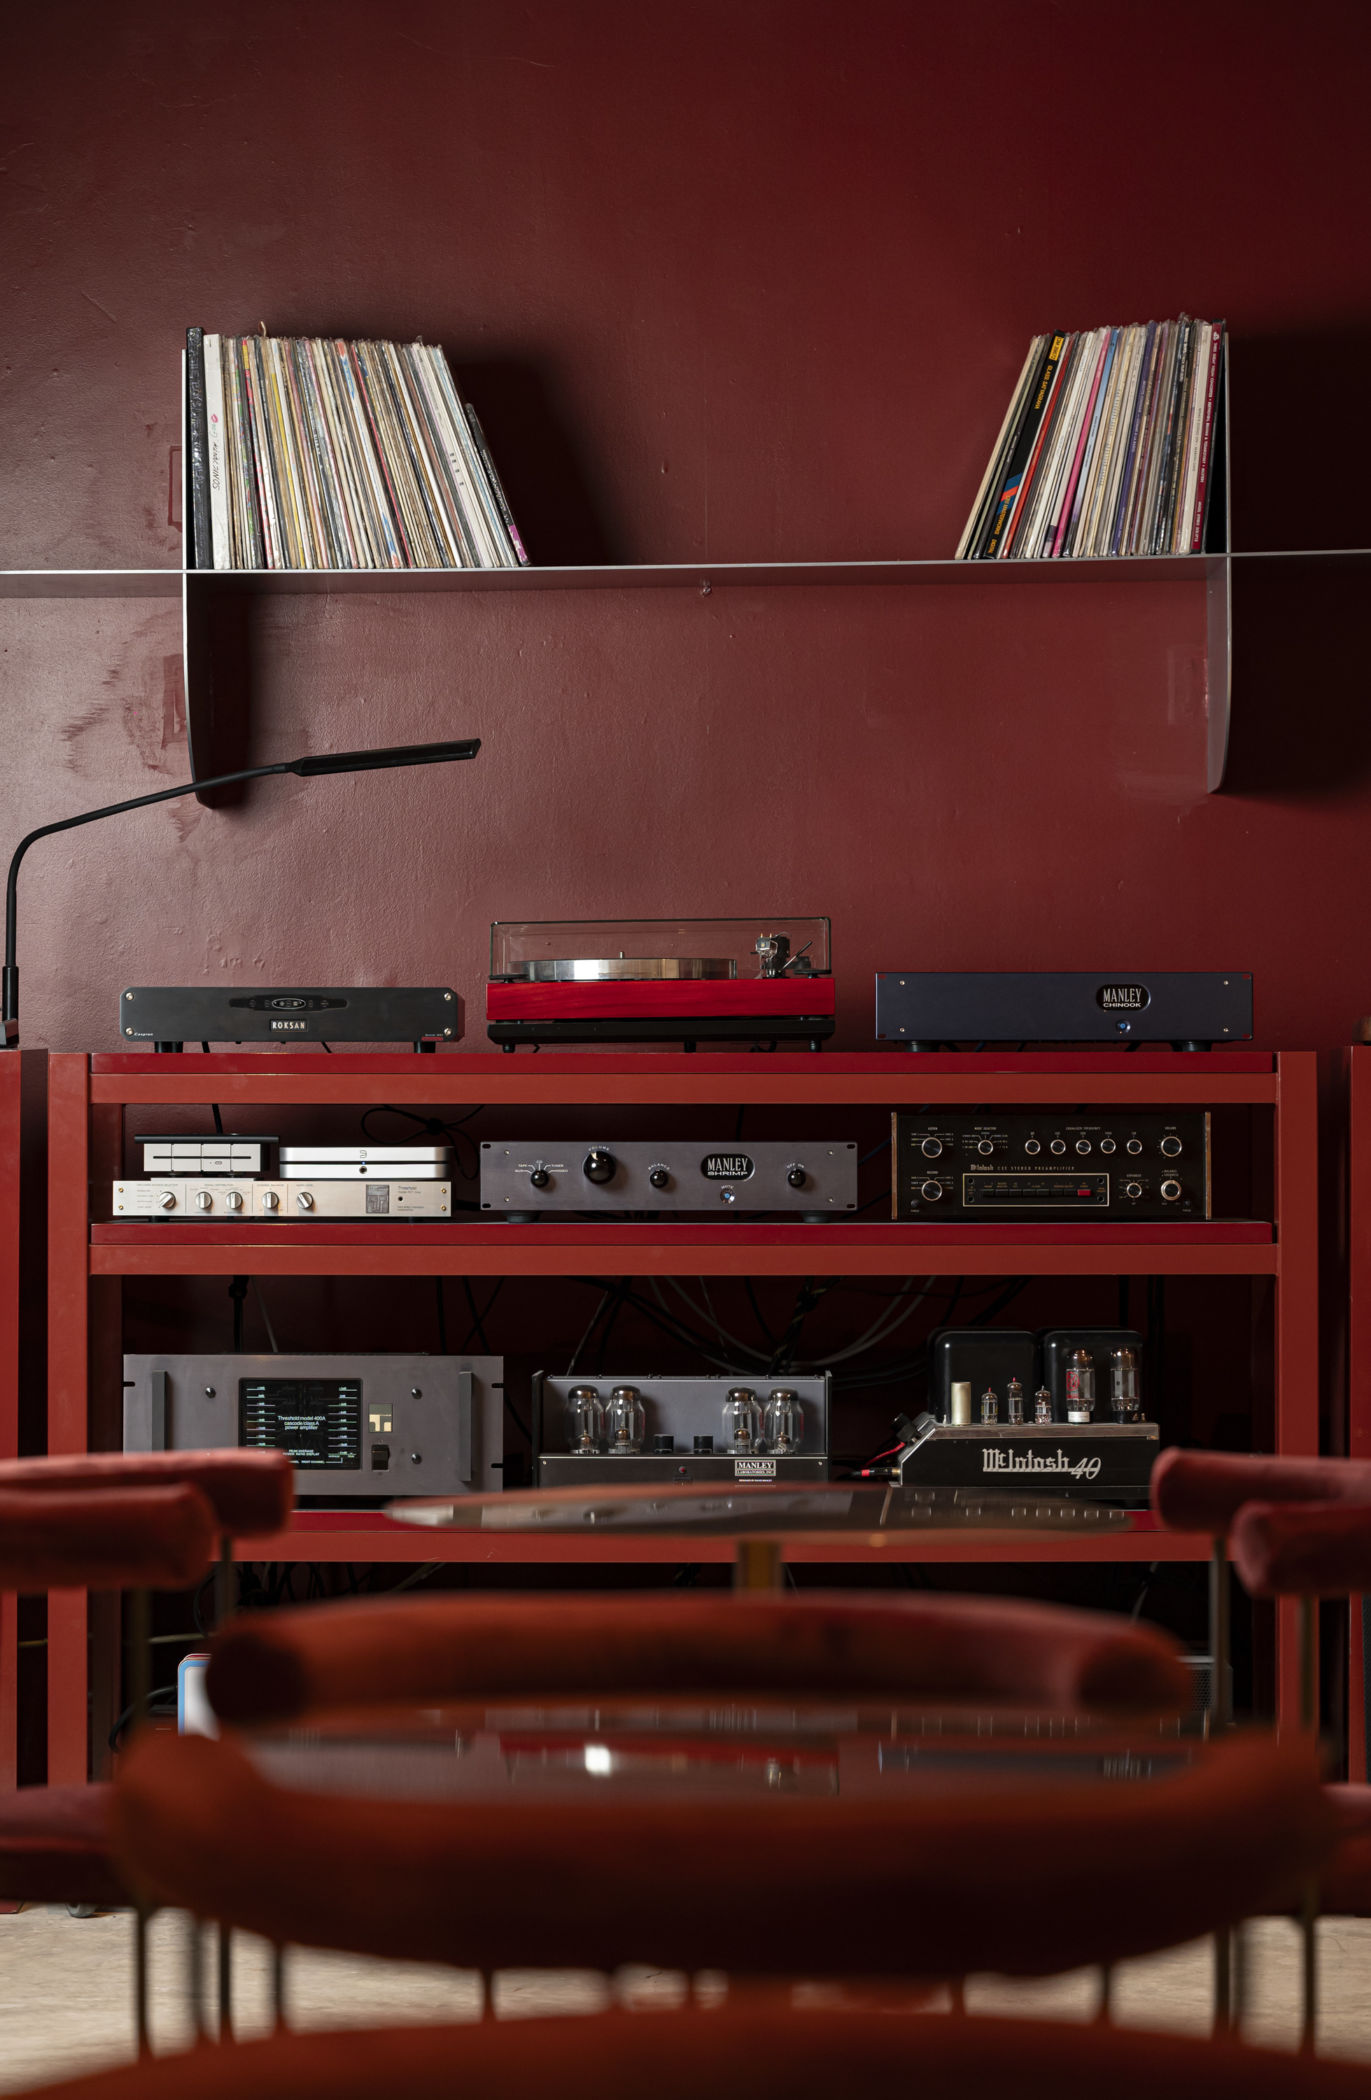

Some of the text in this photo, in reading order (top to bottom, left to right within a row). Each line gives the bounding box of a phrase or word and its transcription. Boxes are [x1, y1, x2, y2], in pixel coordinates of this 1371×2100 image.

[1103, 988, 1142, 1002] MANLEY
[272, 1021, 305, 1029] ROKSAN
[707, 1157, 748, 1171] MANLEY
[982, 1448, 1102, 1480] McIntosh 40
